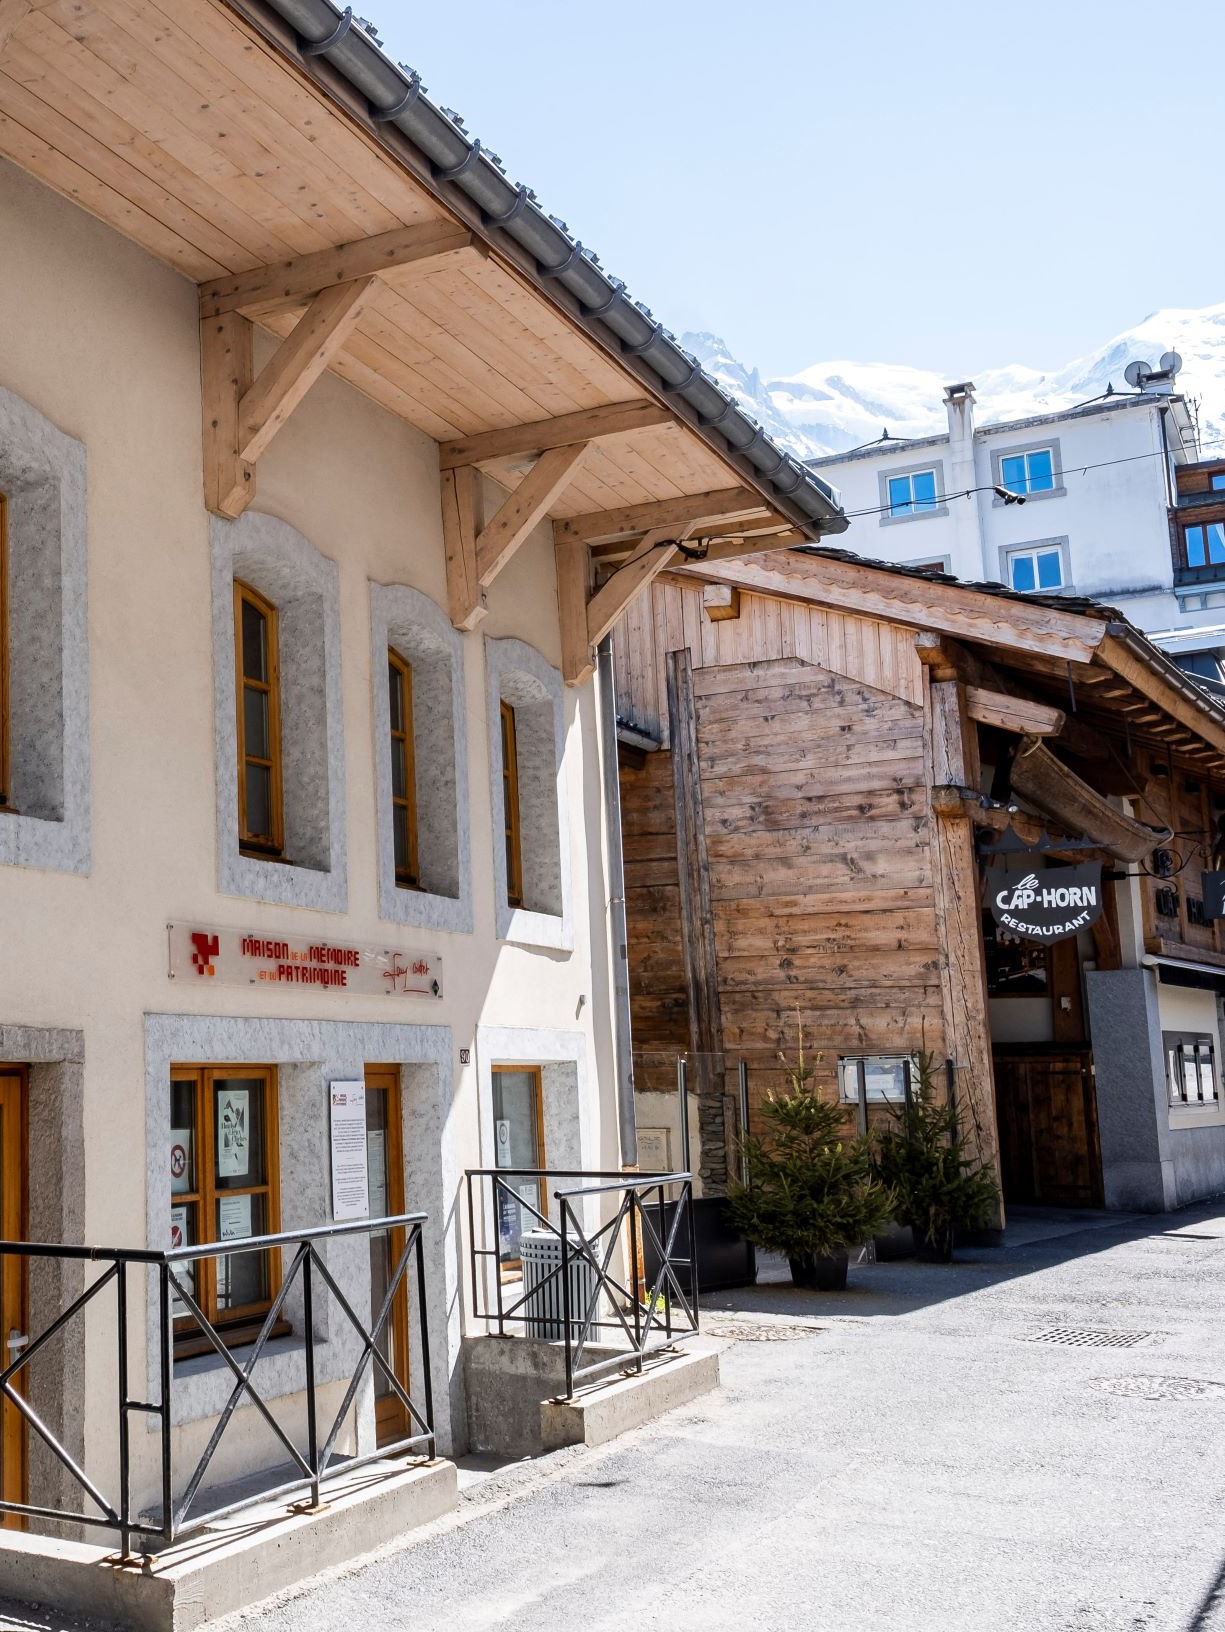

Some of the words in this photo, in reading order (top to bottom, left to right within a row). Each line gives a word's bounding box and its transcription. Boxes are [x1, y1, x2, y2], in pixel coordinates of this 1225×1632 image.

[1012, 873, 1040, 889] le
[996, 886, 1097, 910] CAP-HORN
[1000, 910, 1091, 936] RESTAURANT
[242, 938, 288, 960] MAISON
[259, 970, 267, 980] ET
[278, 965, 347, 986] PATRIMOINE
[461, 1050, 469, 1063] 90
